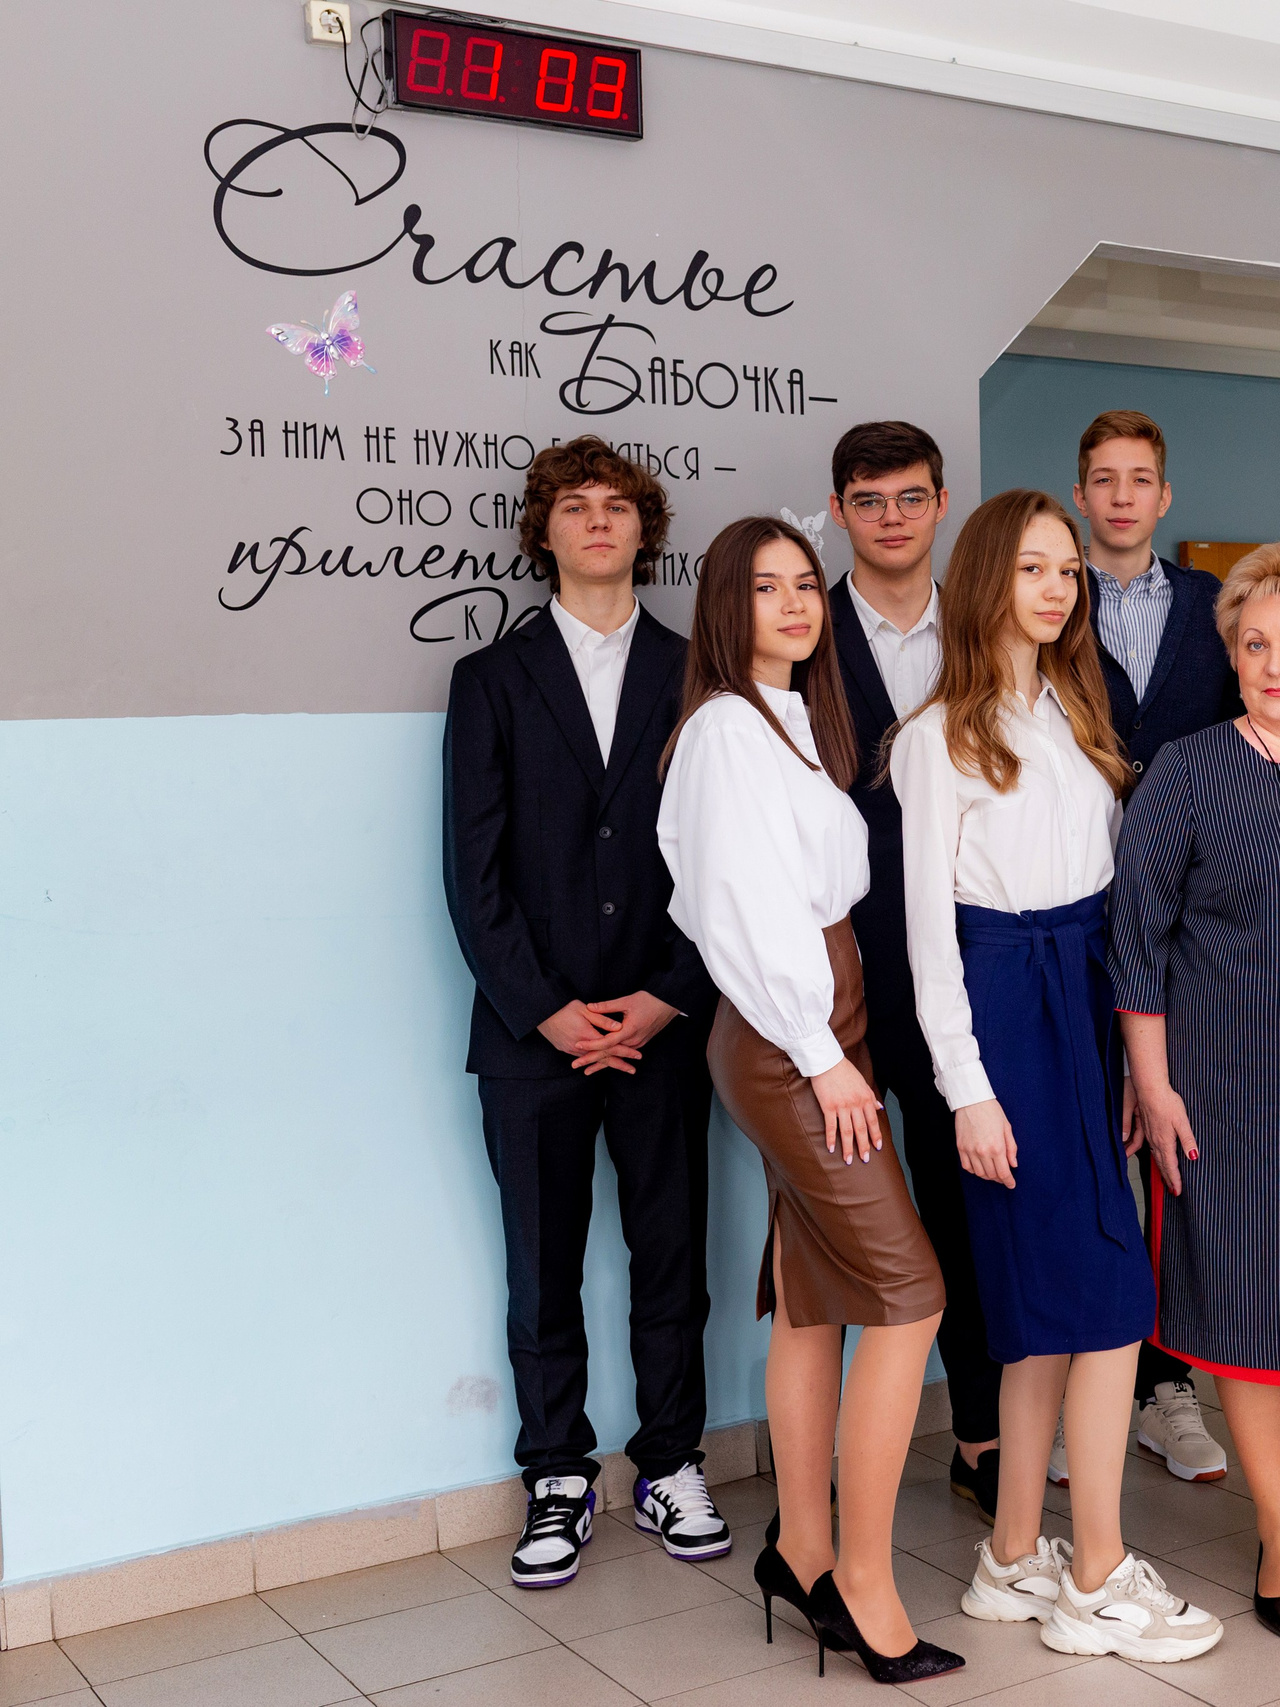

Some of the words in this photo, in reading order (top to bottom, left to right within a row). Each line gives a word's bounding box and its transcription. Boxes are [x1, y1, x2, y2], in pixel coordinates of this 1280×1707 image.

[204, 119, 795, 317] Счастье
[490, 340, 542, 379] КАК
[220, 417, 265, 458] ЗА
[282, 420, 345, 461] НИМ
[364, 426, 396, 464] НЕ
[414, 429, 535, 470] НУЖНО
[356, 488, 452, 527] ОНО
[469, 492, 527, 530] САМ
[218, 526, 549, 611] прилети
